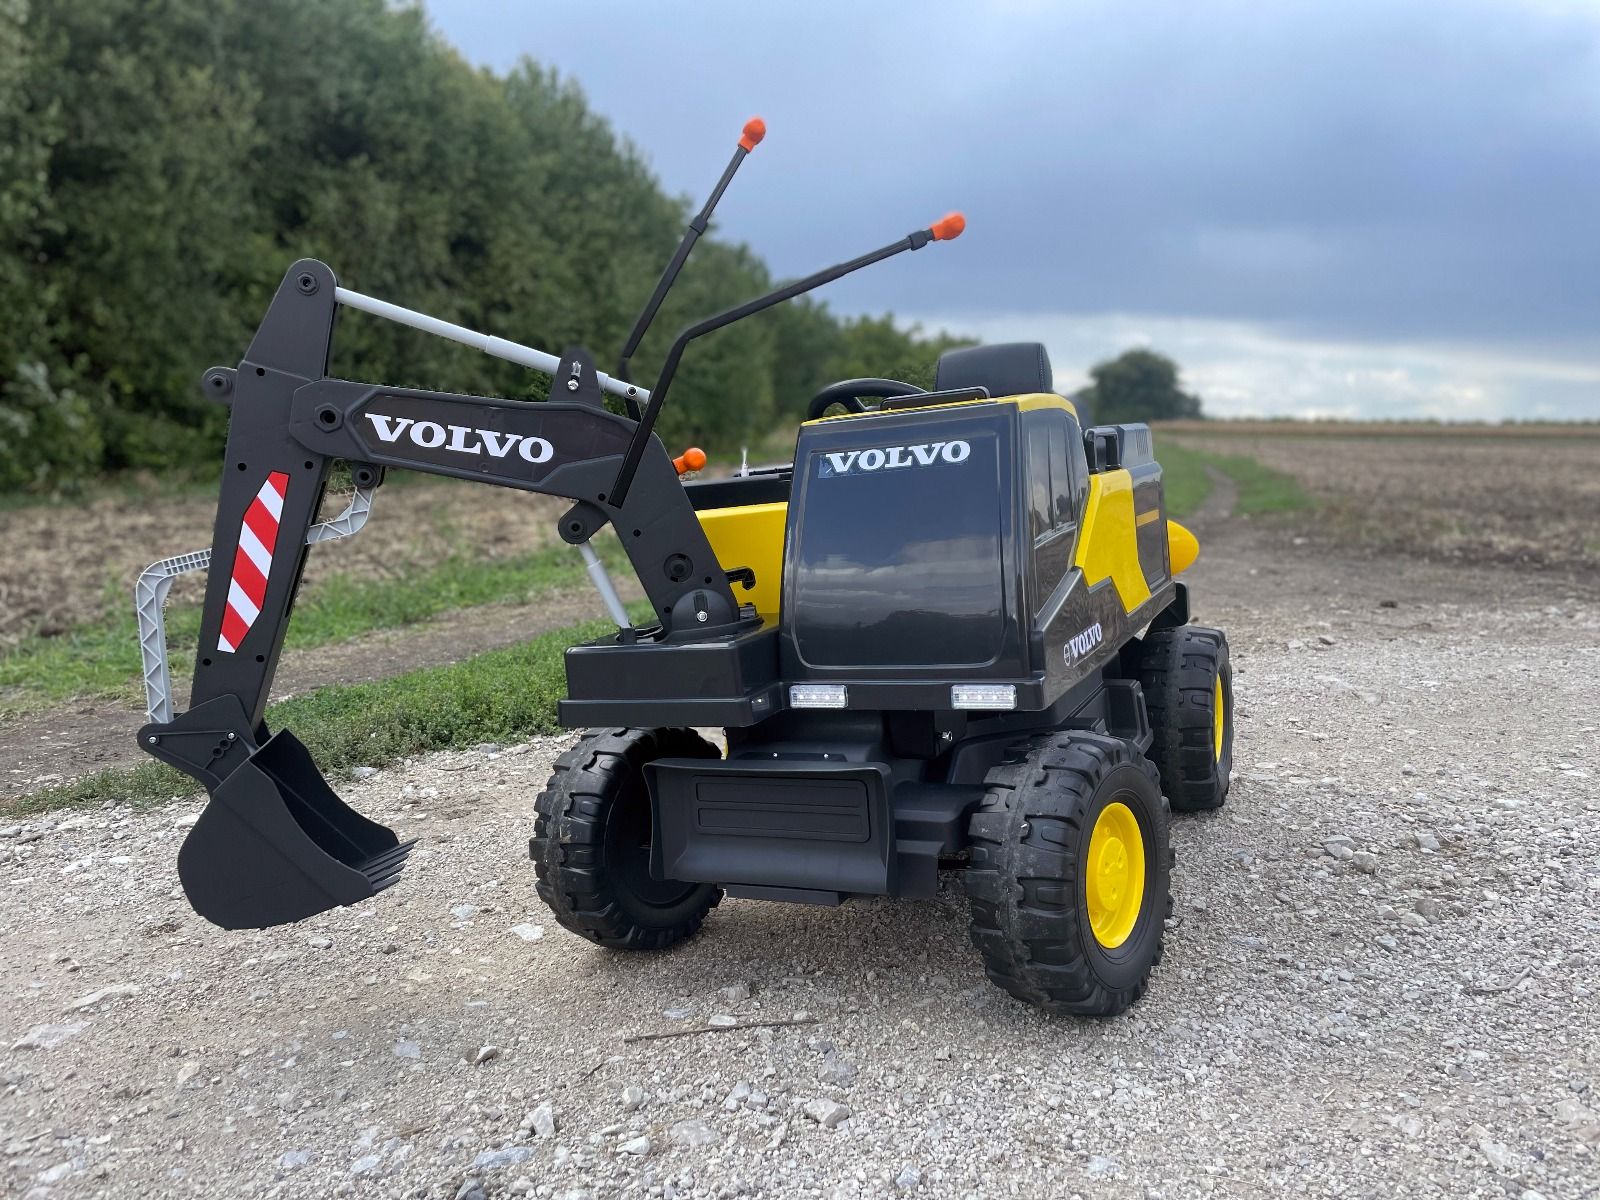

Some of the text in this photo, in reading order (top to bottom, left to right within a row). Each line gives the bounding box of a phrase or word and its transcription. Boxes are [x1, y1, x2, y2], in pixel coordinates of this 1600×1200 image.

[365, 413, 553, 463] VOLVO
[825, 440, 971, 473] VOLVO
[1070, 623, 1102, 658] VOLVO
